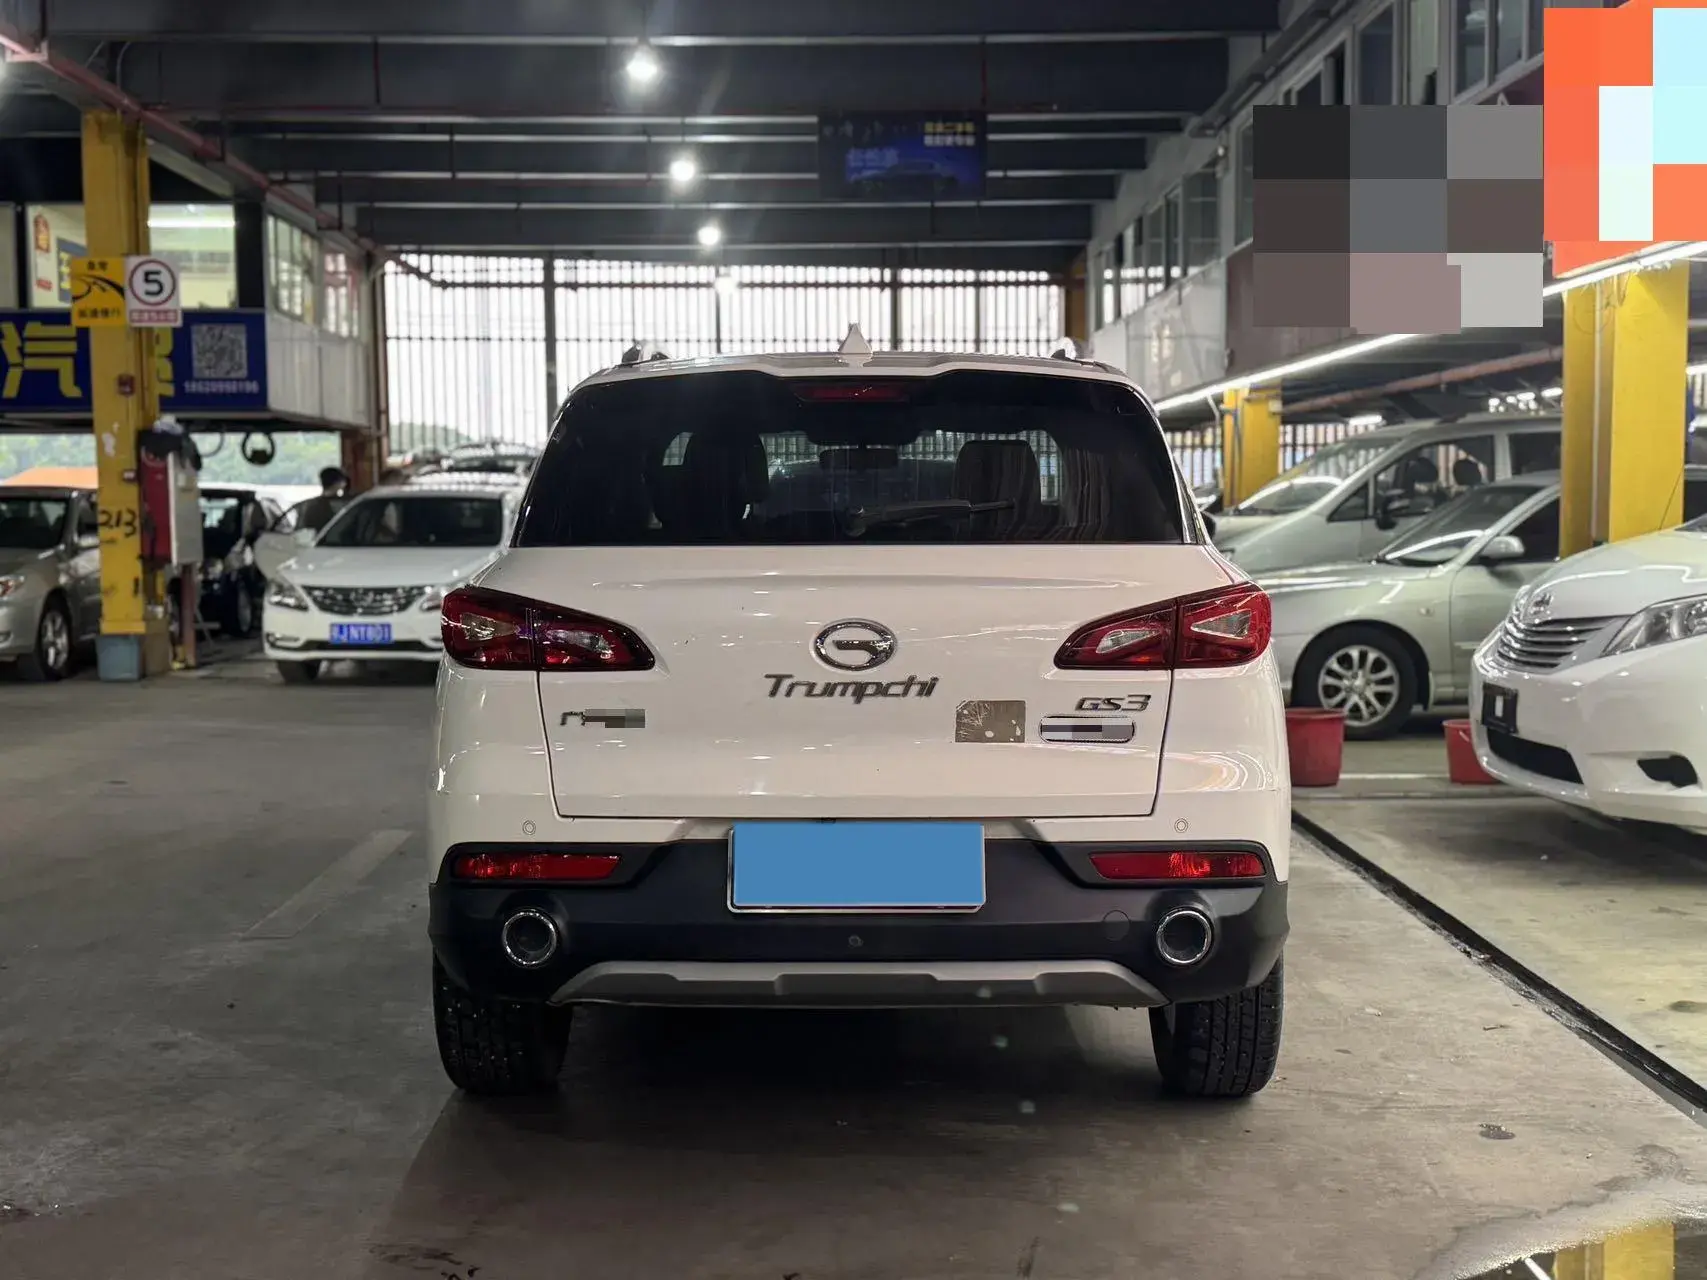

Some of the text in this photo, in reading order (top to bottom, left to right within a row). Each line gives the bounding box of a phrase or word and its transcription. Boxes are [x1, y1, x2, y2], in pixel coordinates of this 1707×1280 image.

[143, 270, 164, 297] 5
[764, 673, 940, 704] Trumpchi
[1075, 694, 1151, 711] GS3
